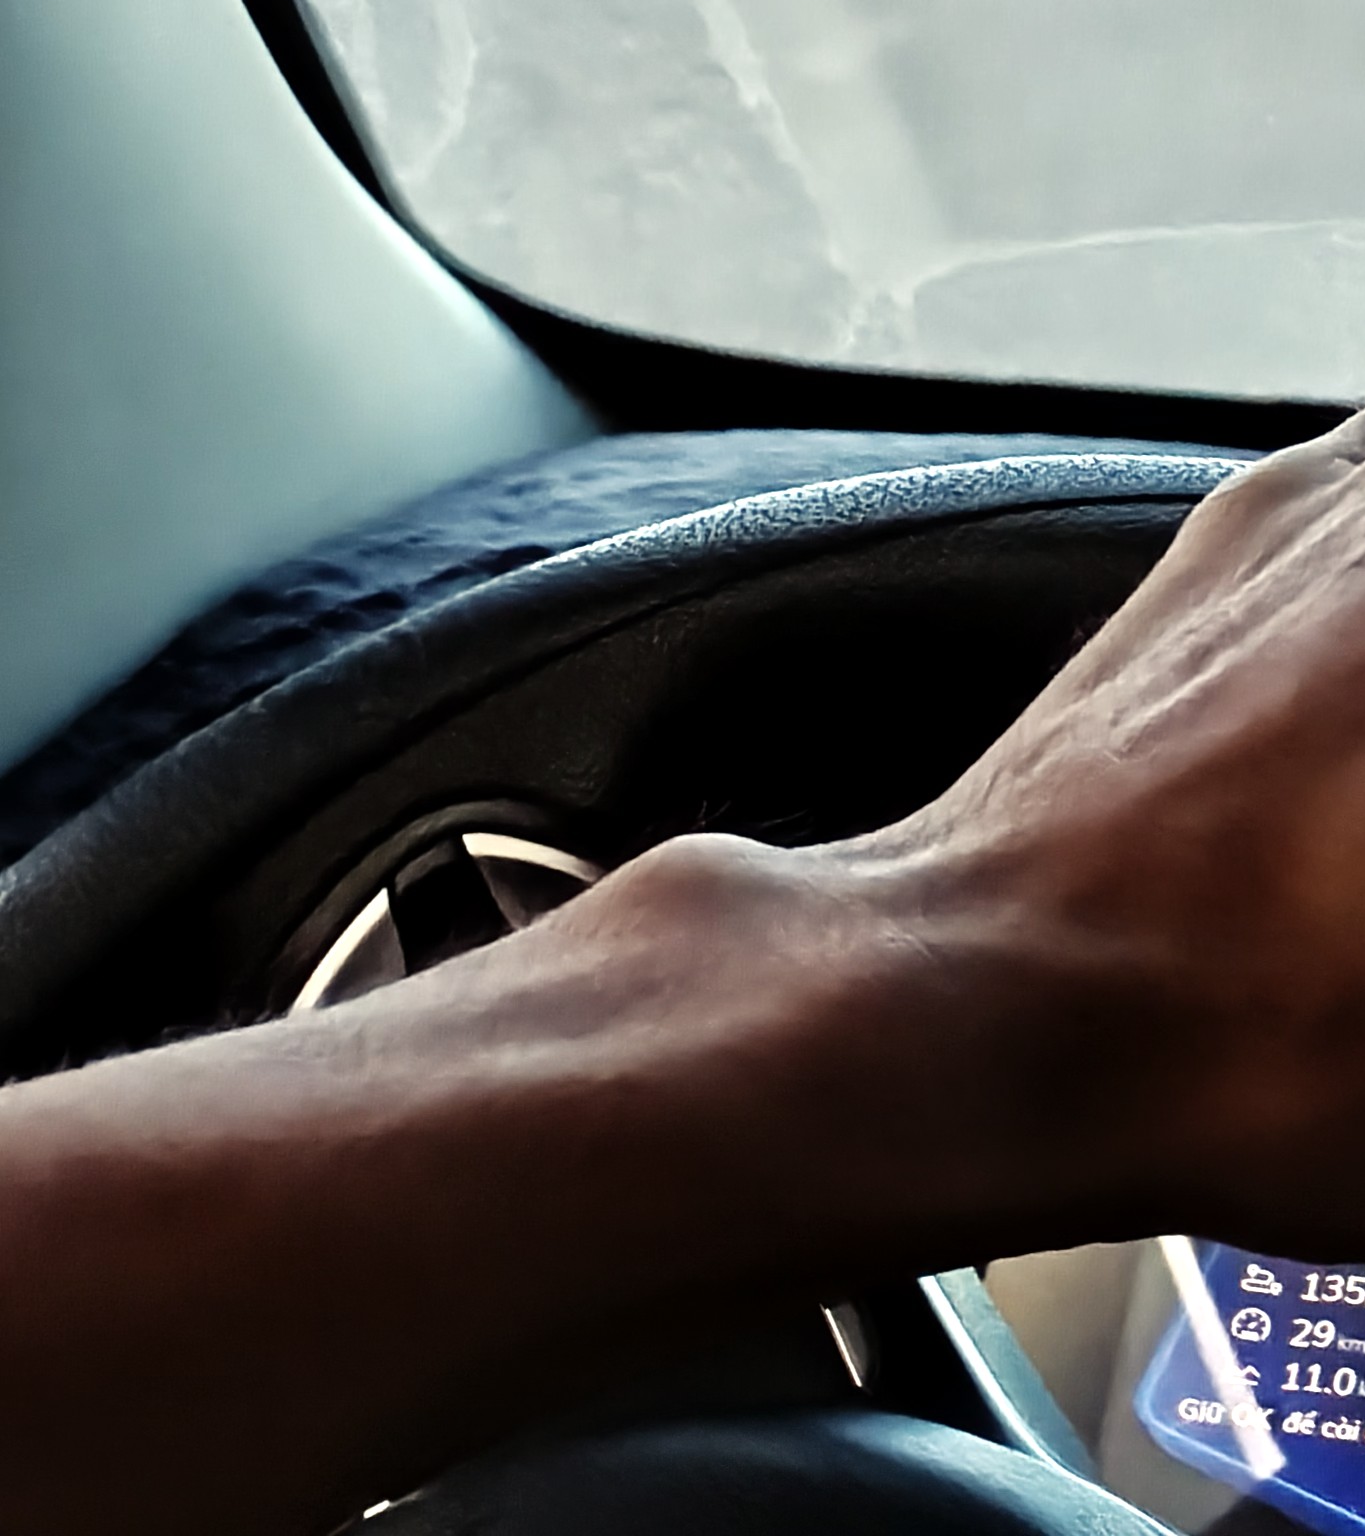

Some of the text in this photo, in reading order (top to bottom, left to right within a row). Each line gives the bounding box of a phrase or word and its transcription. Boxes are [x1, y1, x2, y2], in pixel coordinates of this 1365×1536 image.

[1288, 1317, 1337, 1349] 29
[1280, 1362, 1357, 1397] 11.0
[1320, 1415, 1362, 1441] cài
